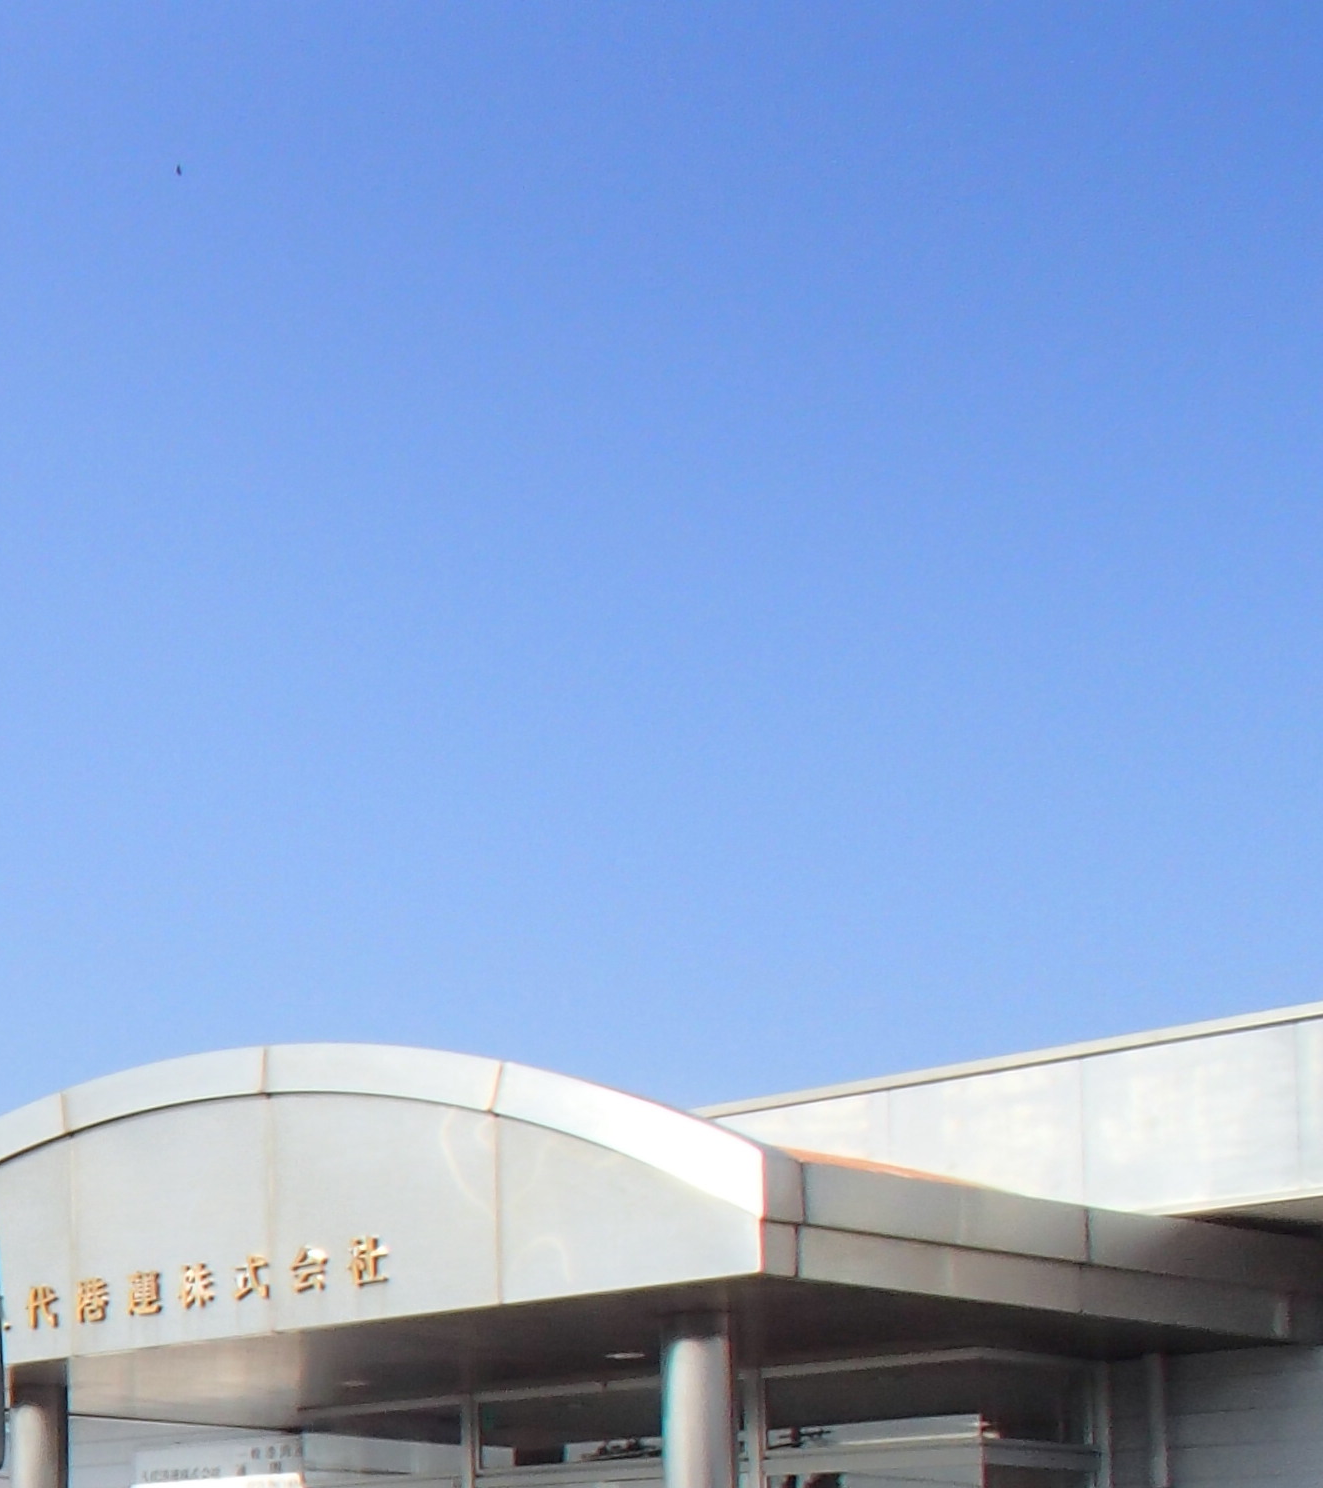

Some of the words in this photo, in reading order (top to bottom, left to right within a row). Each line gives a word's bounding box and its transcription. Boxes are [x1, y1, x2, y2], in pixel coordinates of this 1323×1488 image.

[2, 1233, 390, 1331] 代港運株式会社
